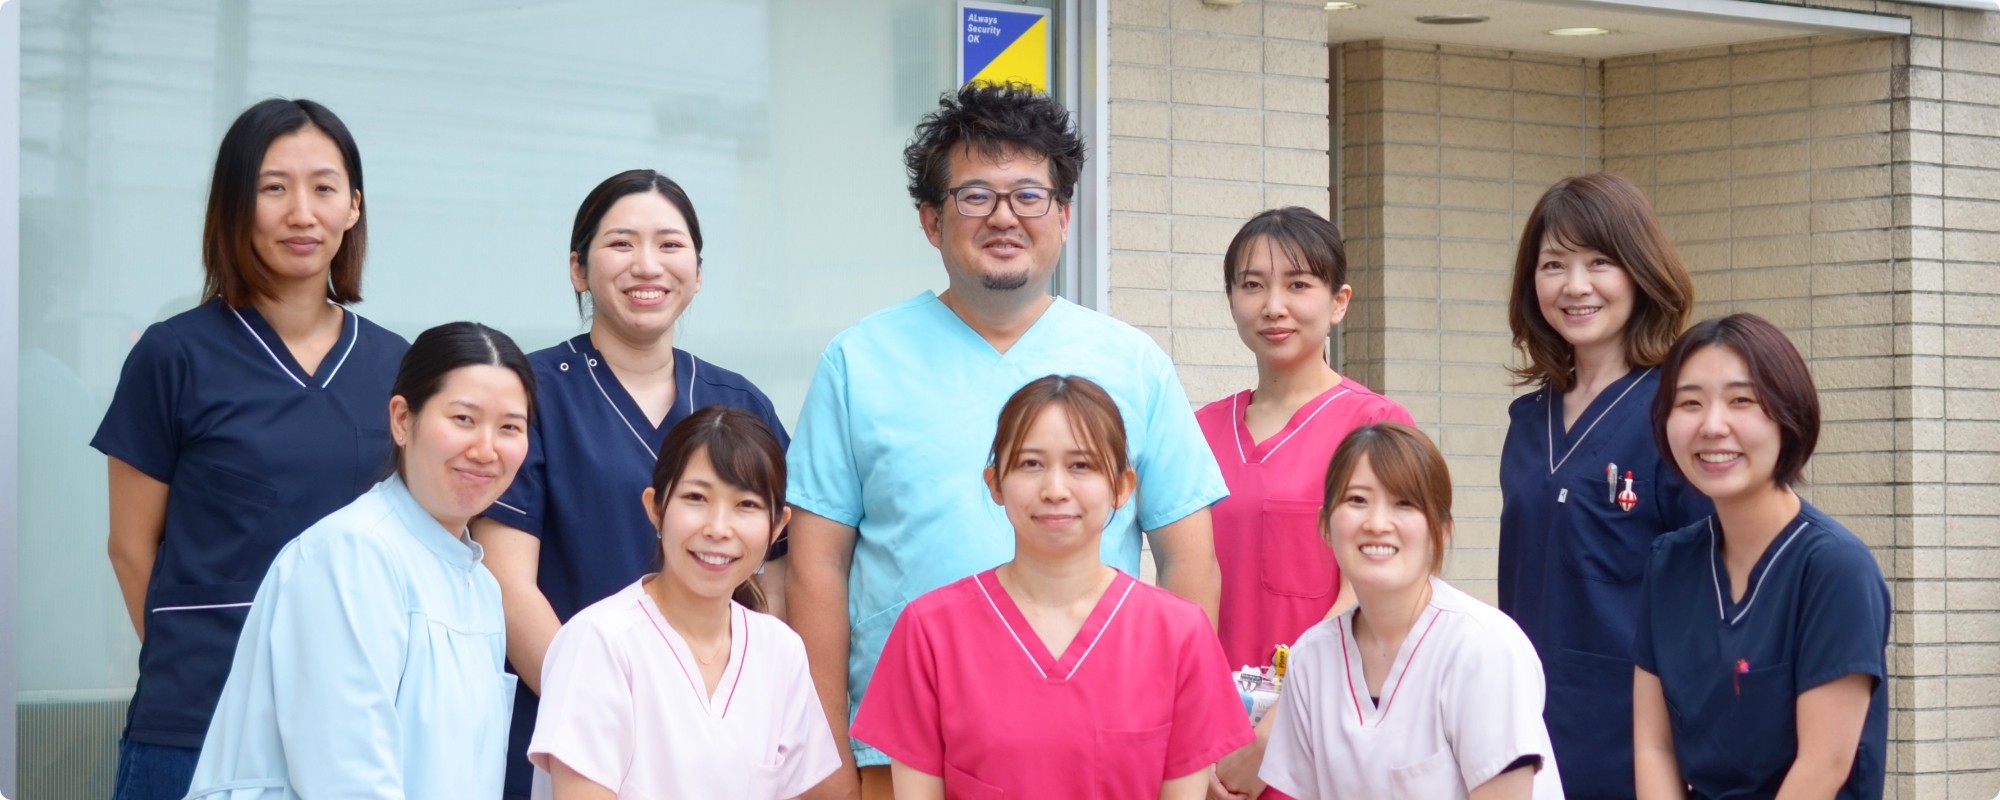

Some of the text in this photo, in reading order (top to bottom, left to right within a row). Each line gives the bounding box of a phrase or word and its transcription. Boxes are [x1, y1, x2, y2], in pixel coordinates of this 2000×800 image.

[968, 13, 997, 25] ALways
[967, 23, 1001, 36] Security
[967, 34, 980, 43] OK
